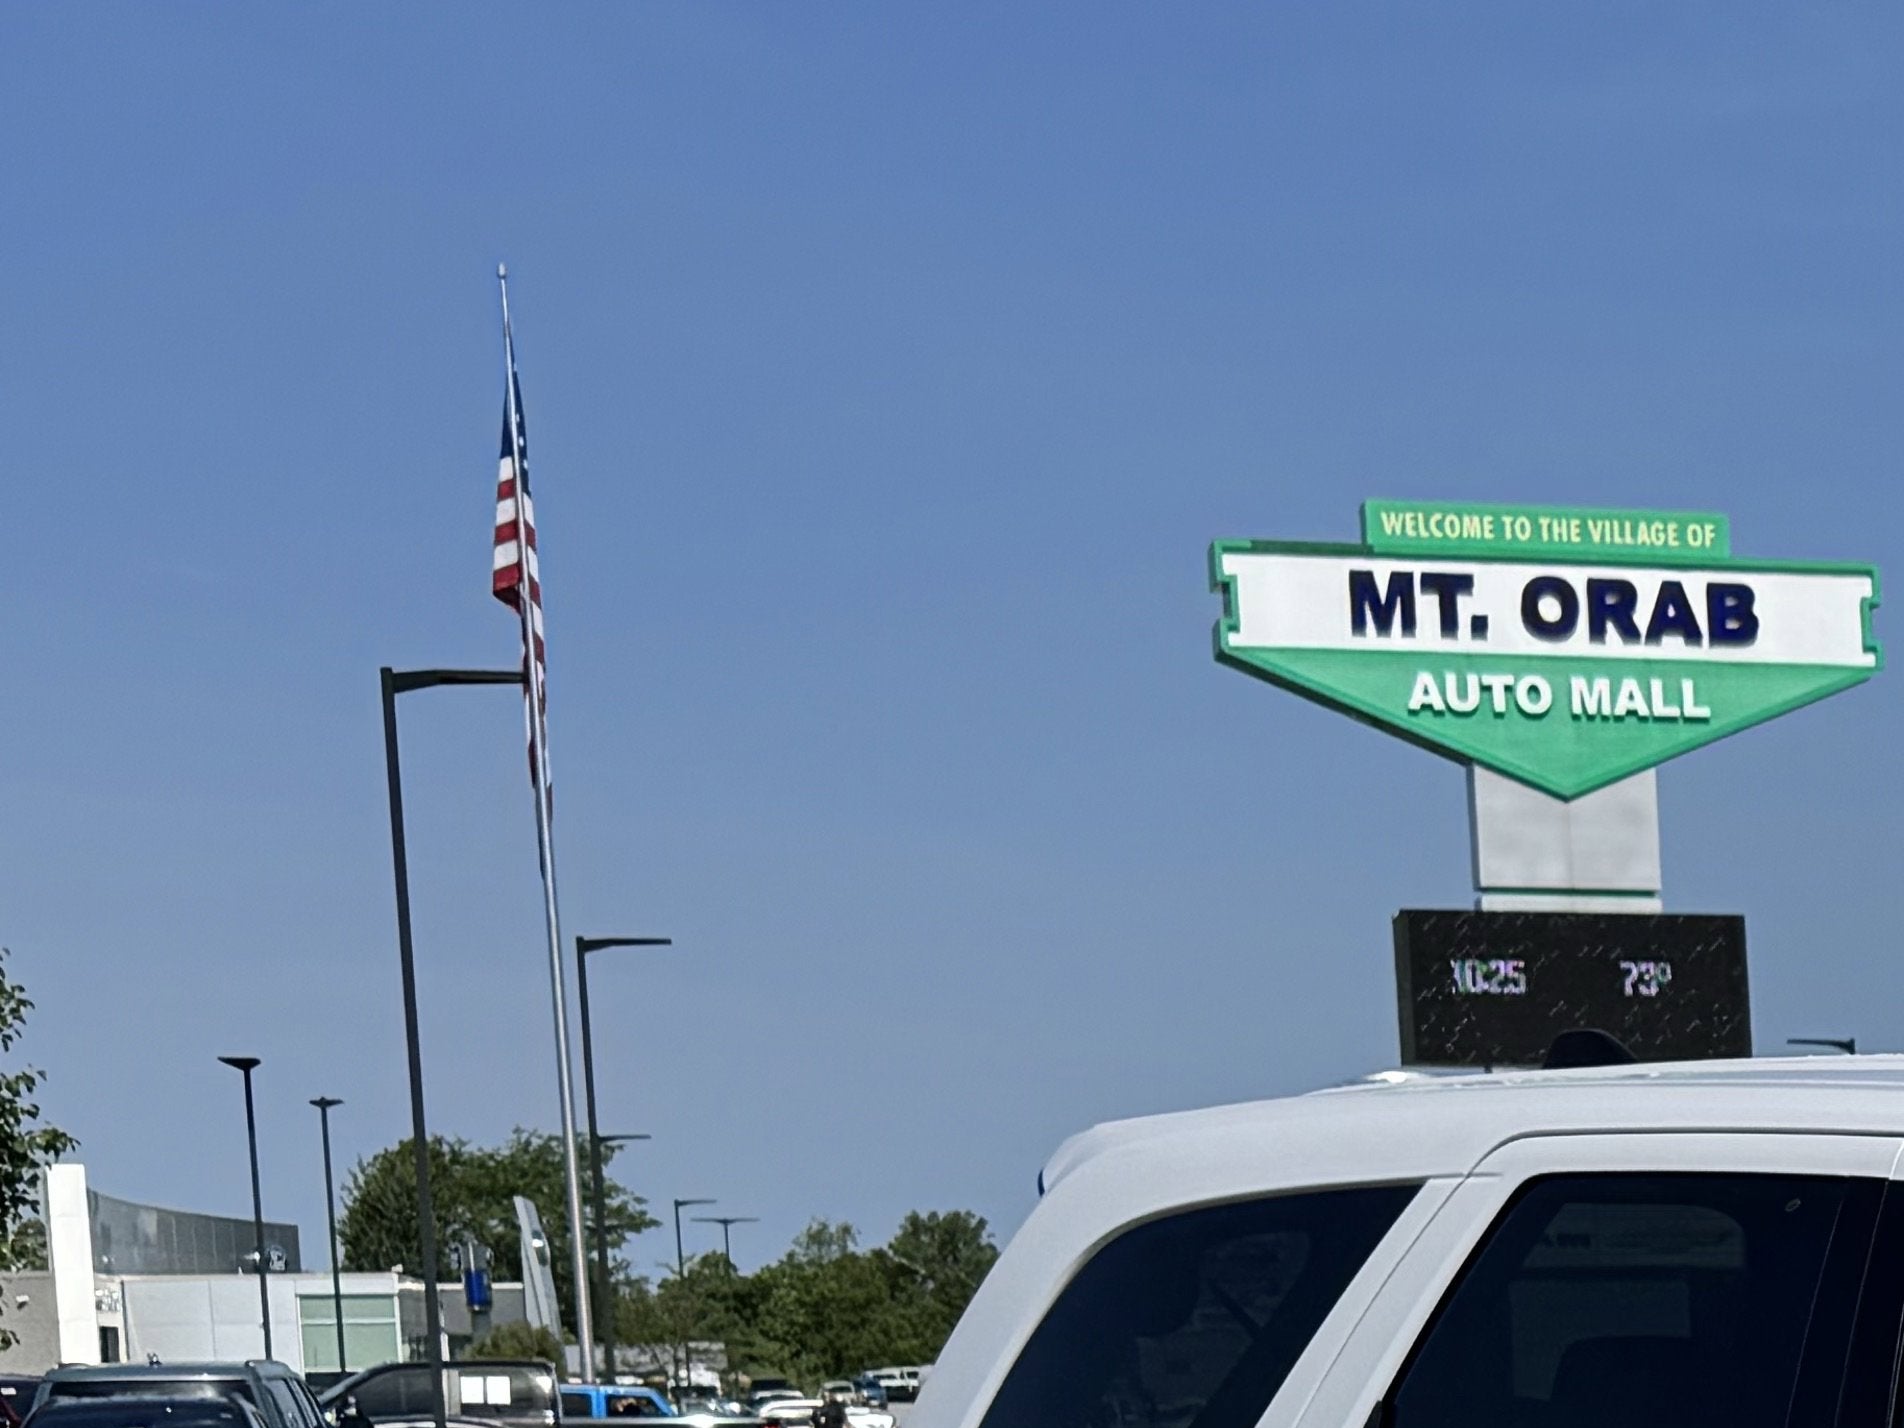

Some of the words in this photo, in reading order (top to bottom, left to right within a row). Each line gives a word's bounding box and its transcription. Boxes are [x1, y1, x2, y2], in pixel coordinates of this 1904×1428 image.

[1381, 511, 1496, 540] WELCOME
[1502, 515, 1532, 541] TO
[1539, 516, 1582, 543] THE
[1587, 519, 1679, 547] VILLAGE
[1686, 523, 1716, 548] OF
[1349, 569, 1489, 641] MT.
[1520, 575, 1760, 648] ORAB
[1407, 671, 1552, 715] AUTO
[1570, 675, 1711, 719] MALL
